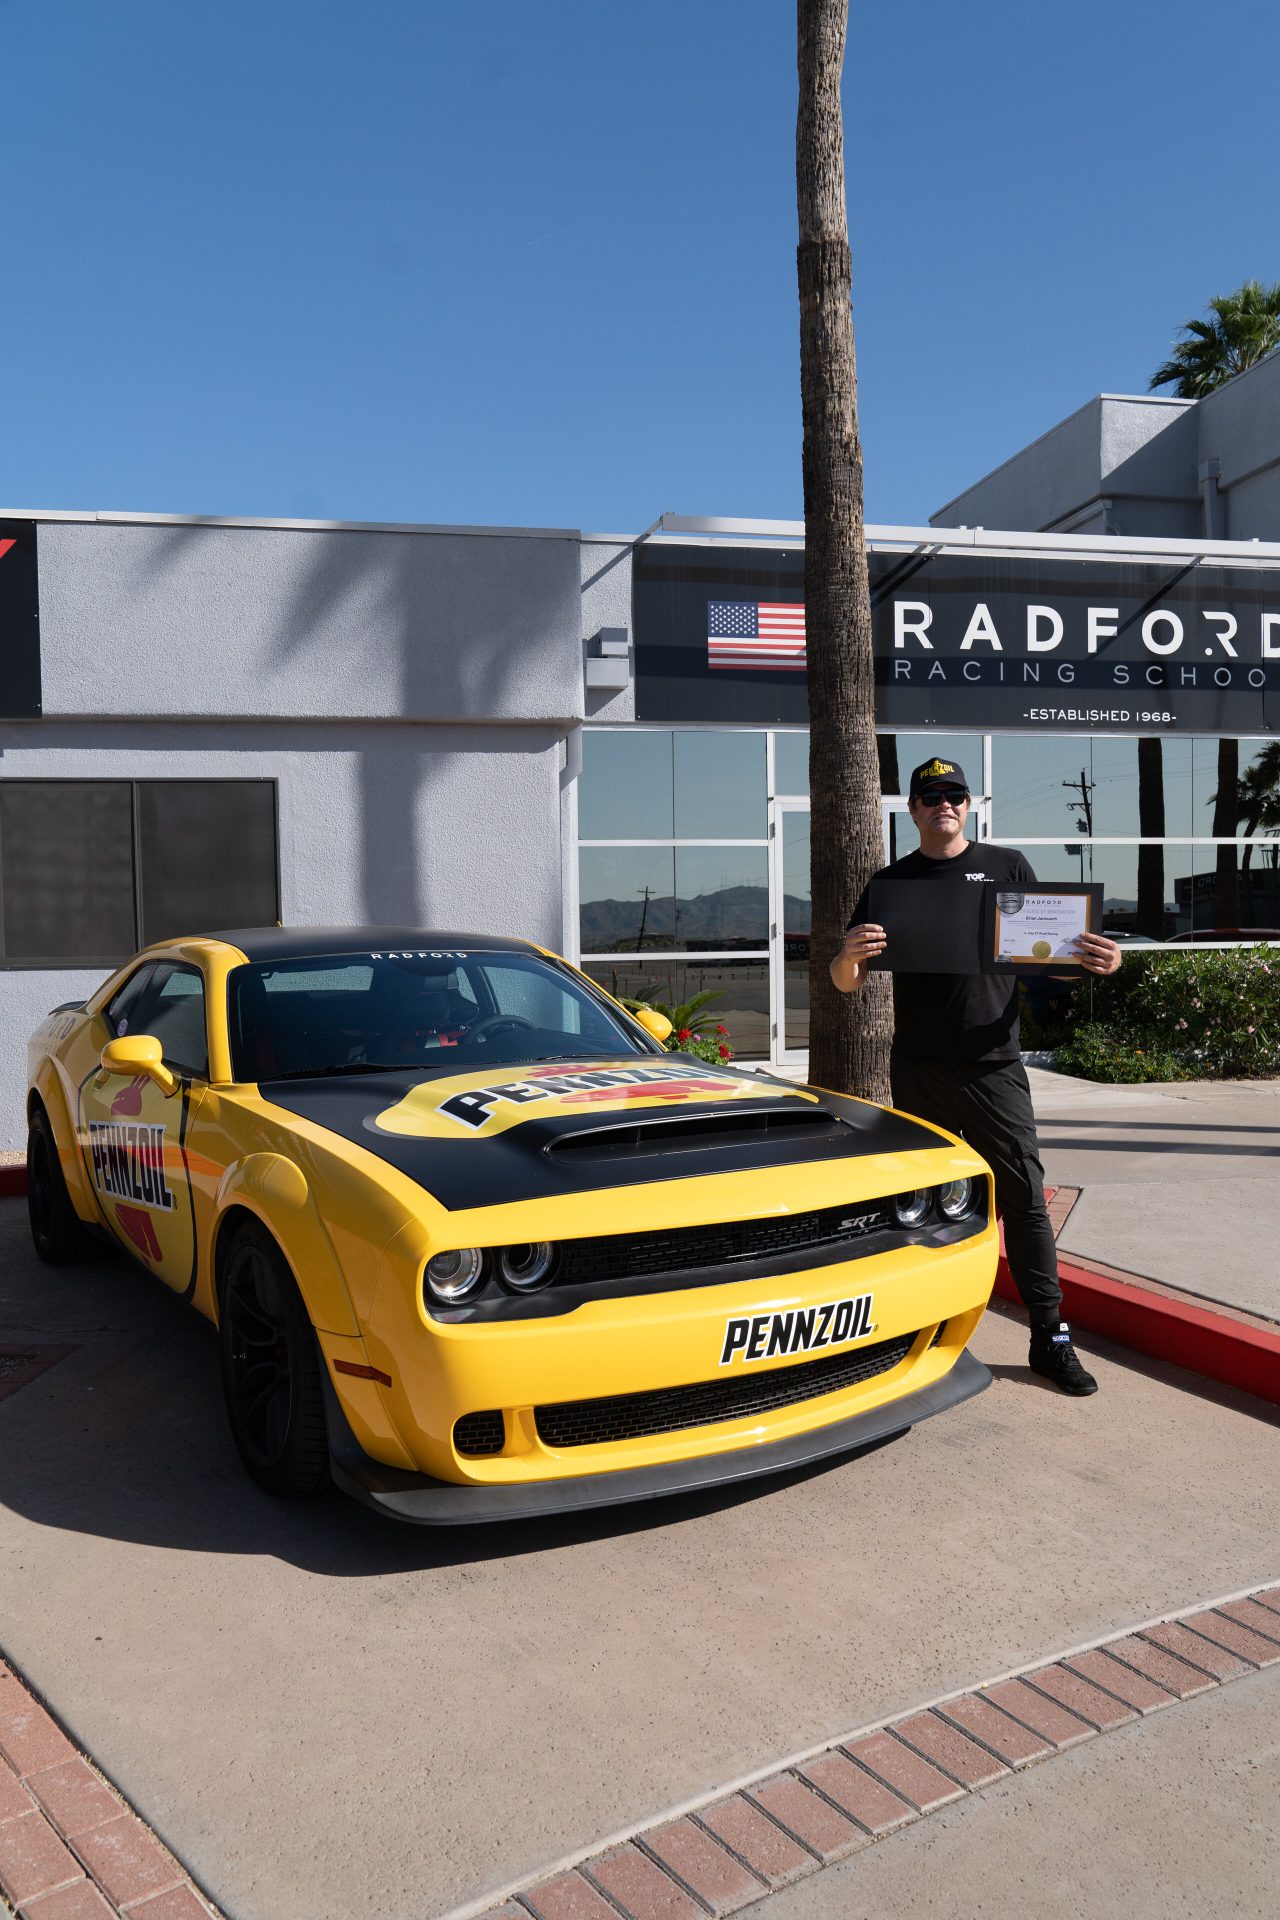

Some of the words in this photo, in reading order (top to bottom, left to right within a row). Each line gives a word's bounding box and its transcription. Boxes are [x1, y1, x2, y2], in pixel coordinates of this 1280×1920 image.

[894, 600, 1280, 658] RADFORD
[894, 659, 1076, 684] RACING
[964, 872, 986, 881] TOP
[369, 951, 469, 961] RADFORD
[436, 1065, 734, 1131] PENNZOIL
[89, 1121, 172, 1211] PENNZOIL
[837, 1212, 881, 1230] SRT
[719, 1293, 873, 1365] PENNZOIL
